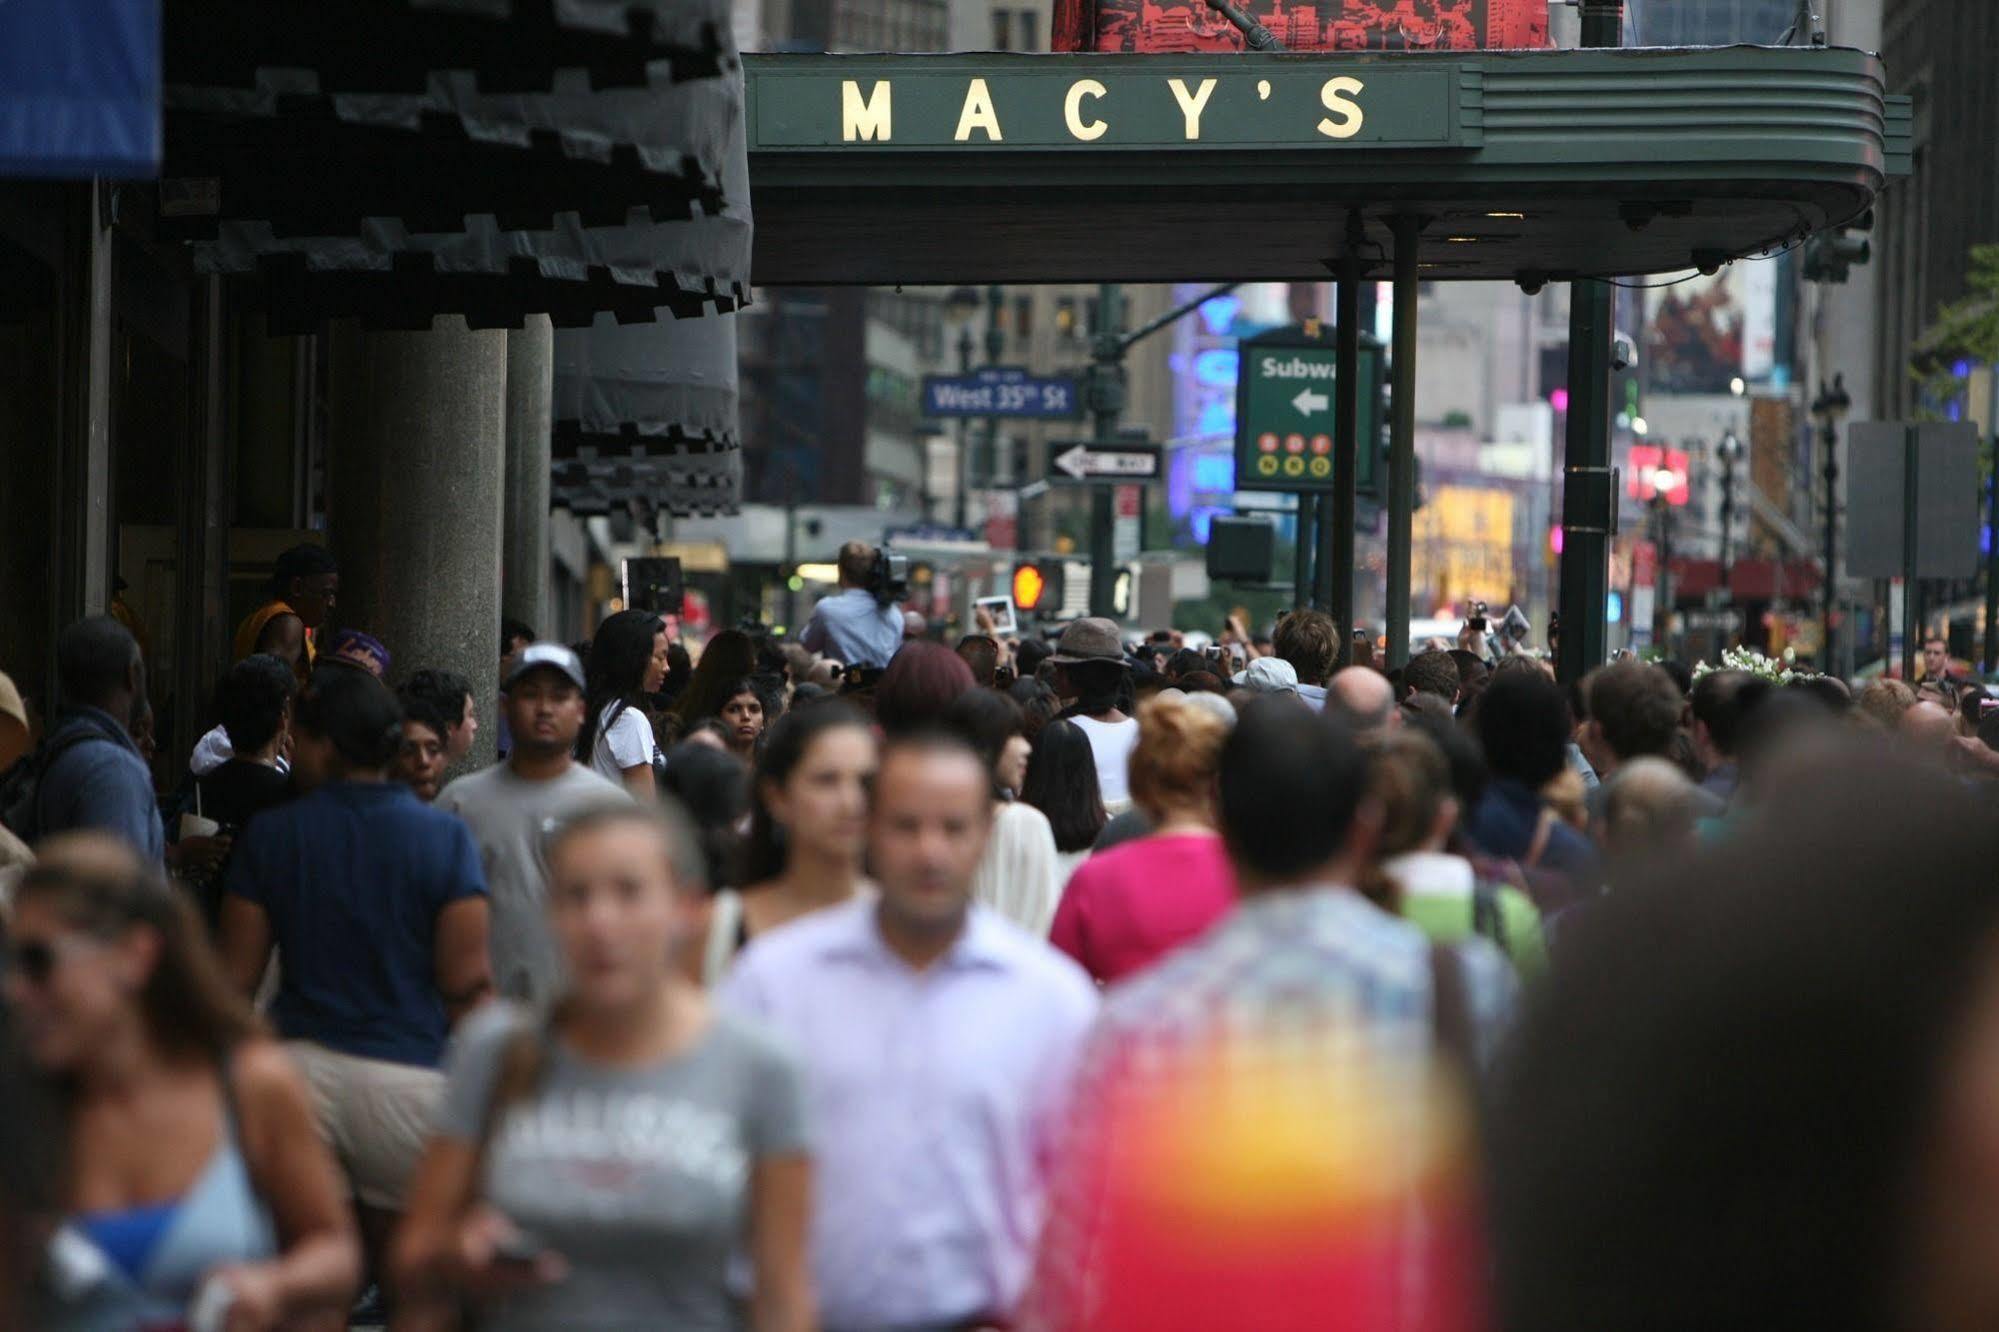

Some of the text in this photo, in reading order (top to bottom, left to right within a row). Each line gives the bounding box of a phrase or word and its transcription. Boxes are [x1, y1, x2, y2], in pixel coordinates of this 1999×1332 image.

[842, 76, 1365, 141] MACY'S
[933, 384, 1066, 410] West 35th St
[1071, 453, 1146, 471] ONE WAY
